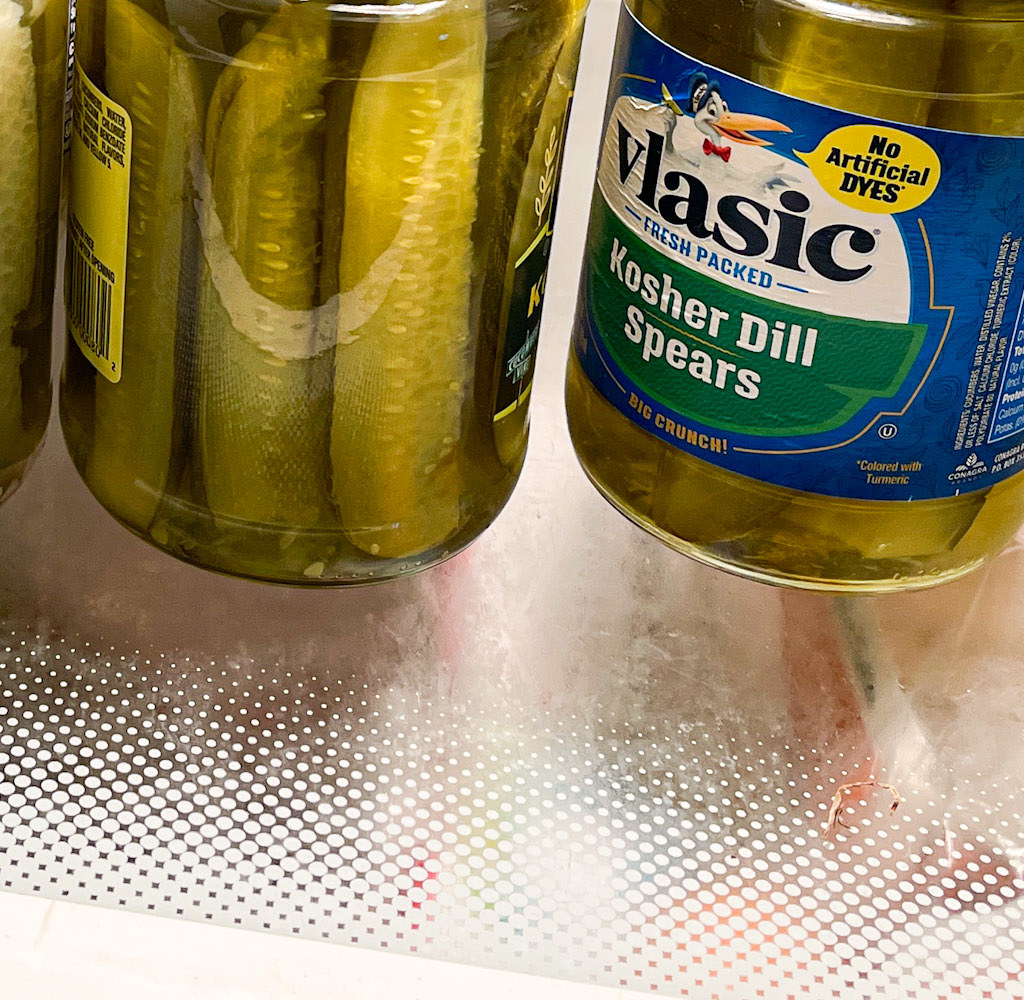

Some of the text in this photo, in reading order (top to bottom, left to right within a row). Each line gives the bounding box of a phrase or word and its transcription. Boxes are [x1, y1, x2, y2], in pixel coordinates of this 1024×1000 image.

[868, 133, 902, 159] No
[826, 148, 931, 187] Artificial
[616, 118, 876, 283] vlasic
[643, 216, 773, 290] FRESH PACKED
[609, 238, 730, 339] Kosher
[736, 311, 818, 368] Dill
[979, 308, 994, 341] DISTILLED
[624, 303, 761, 400] Spears
[628, 392, 728, 455] BIG CRUNCH!
[866, 473, 910, 485] Turmeric
[900, 461, 922, 472] with
[948, 466, 987, 481] CONAGRA
